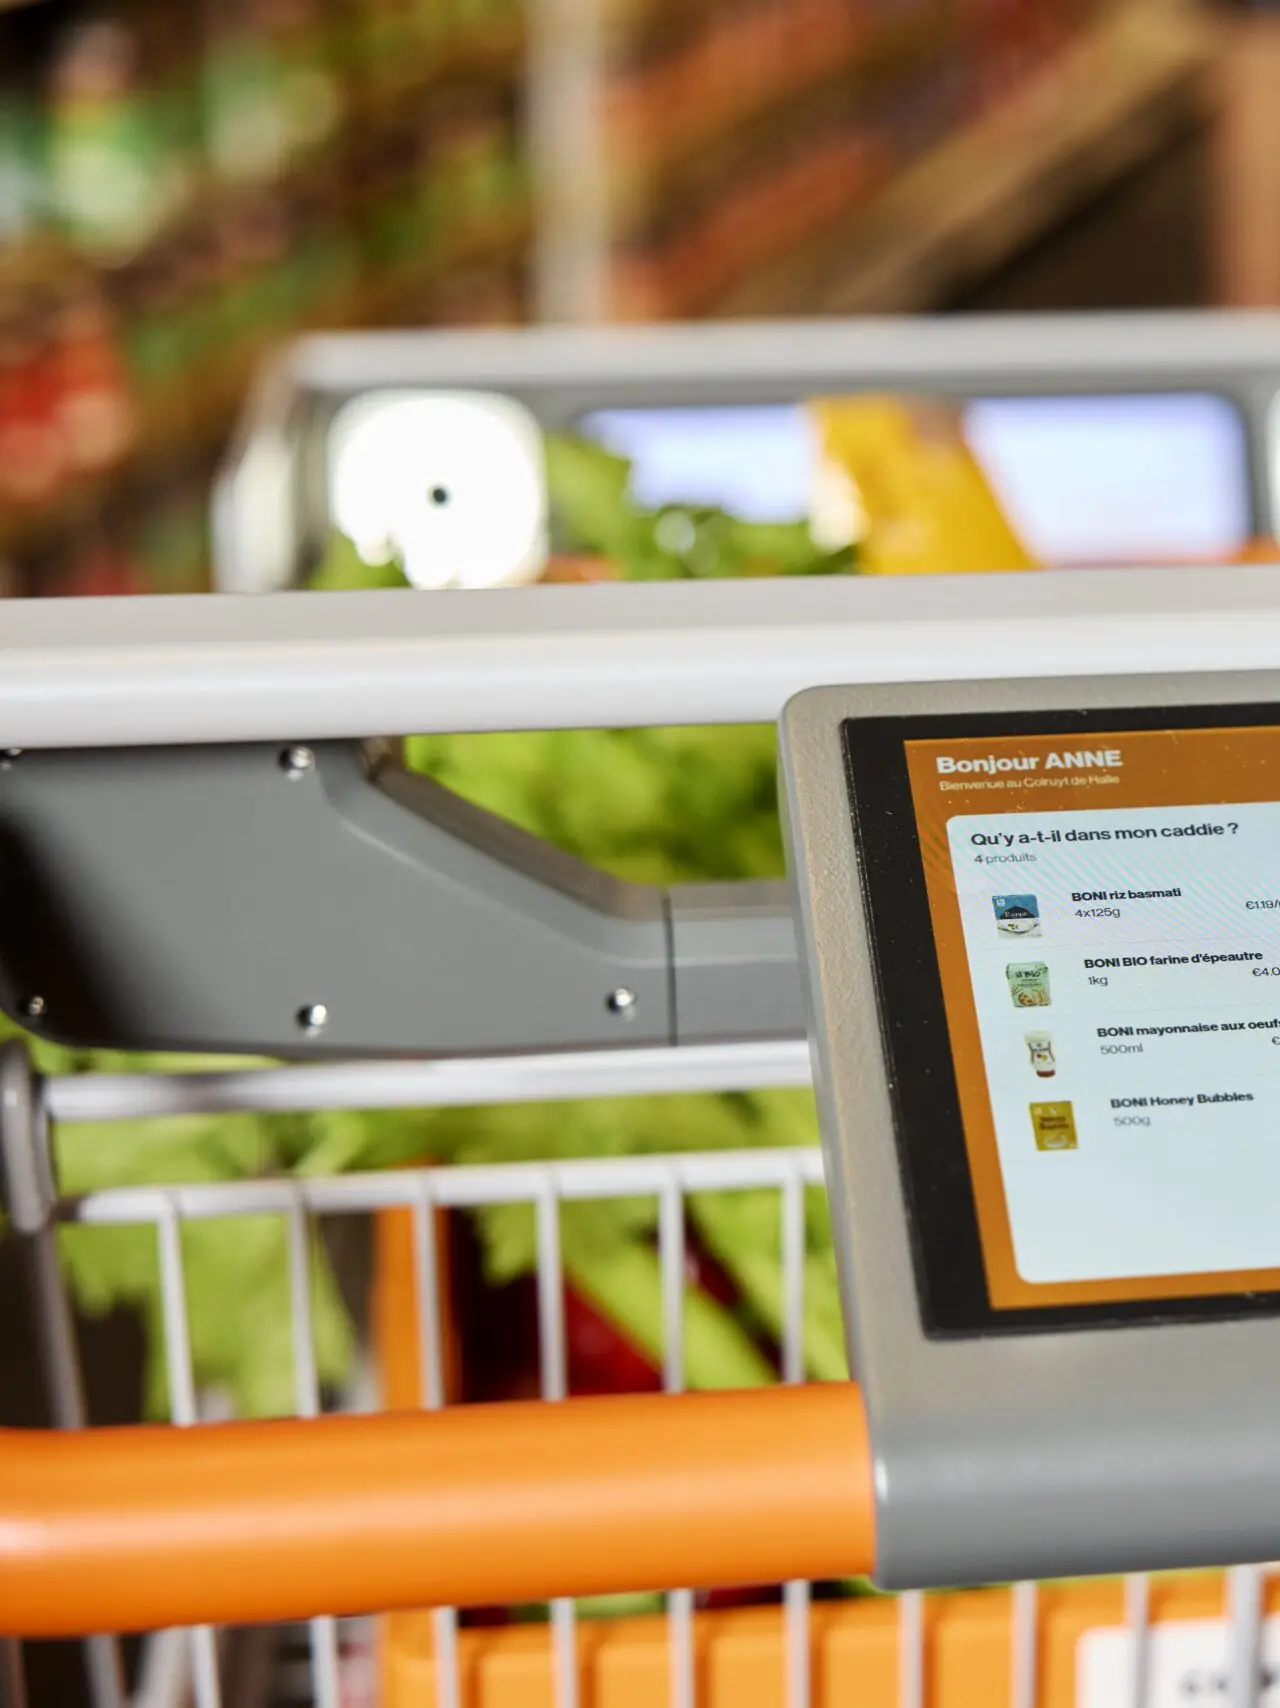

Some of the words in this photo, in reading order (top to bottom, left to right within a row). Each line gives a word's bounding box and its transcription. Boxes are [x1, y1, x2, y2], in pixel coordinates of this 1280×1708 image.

[936, 755, 1039, 775] Bonjour
[1045, 750, 1123, 770] ANNE
[939, 780, 1005, 792] Bienvenue
[1006, 779, 1022, 788] au
[1023, 775, 1069, 788] Colruyt
[1071, 777, 1087, 785] de
[1088, 775, 1120, 785] Halle
[971, 831, 1014, 849] Qu'y
[1018, 828, 1062, 845] a-t-il
[1065, 827, 1112, 843] dans
[1115, 826, 1158, 840] mon
[1161, 822, 1225, 838] caddie
[1227, 822, 1240, 836] ?
[974, 854, 984, 865] 4
[985, 851, 1037, 865] produits
[1072, 891, 1107, 902] BONI
[1109, 890, 1126, 900] riz
[1128, 888, 1182, 900] basmati
[1075, 907, 1120, 919] 4x125g
[1084, 958, 1120, 969] BONI
[1122, 956, 1148, 966] BIO
[1149, 953, 1189, 965] farine
[1191, 951, 1263, 966] d'épeautre
[1088, 975, 1108, 987] 1kg
[1097, 1027, 1134, 1038] BONI
[1135, 1022, 1219, 1037] mayonnaise
[1220, 1021, 1246, 1032] aux
[1100, 1043, 1144, 1055] 500ml
[1110, 1097, 1148, 1109] BONI
[1150, 1094, 1194, 1108] Honey
[1197, 1091, 1254, 1105] Bubbles
[1114, 1115, 1151, 1127] 500g
